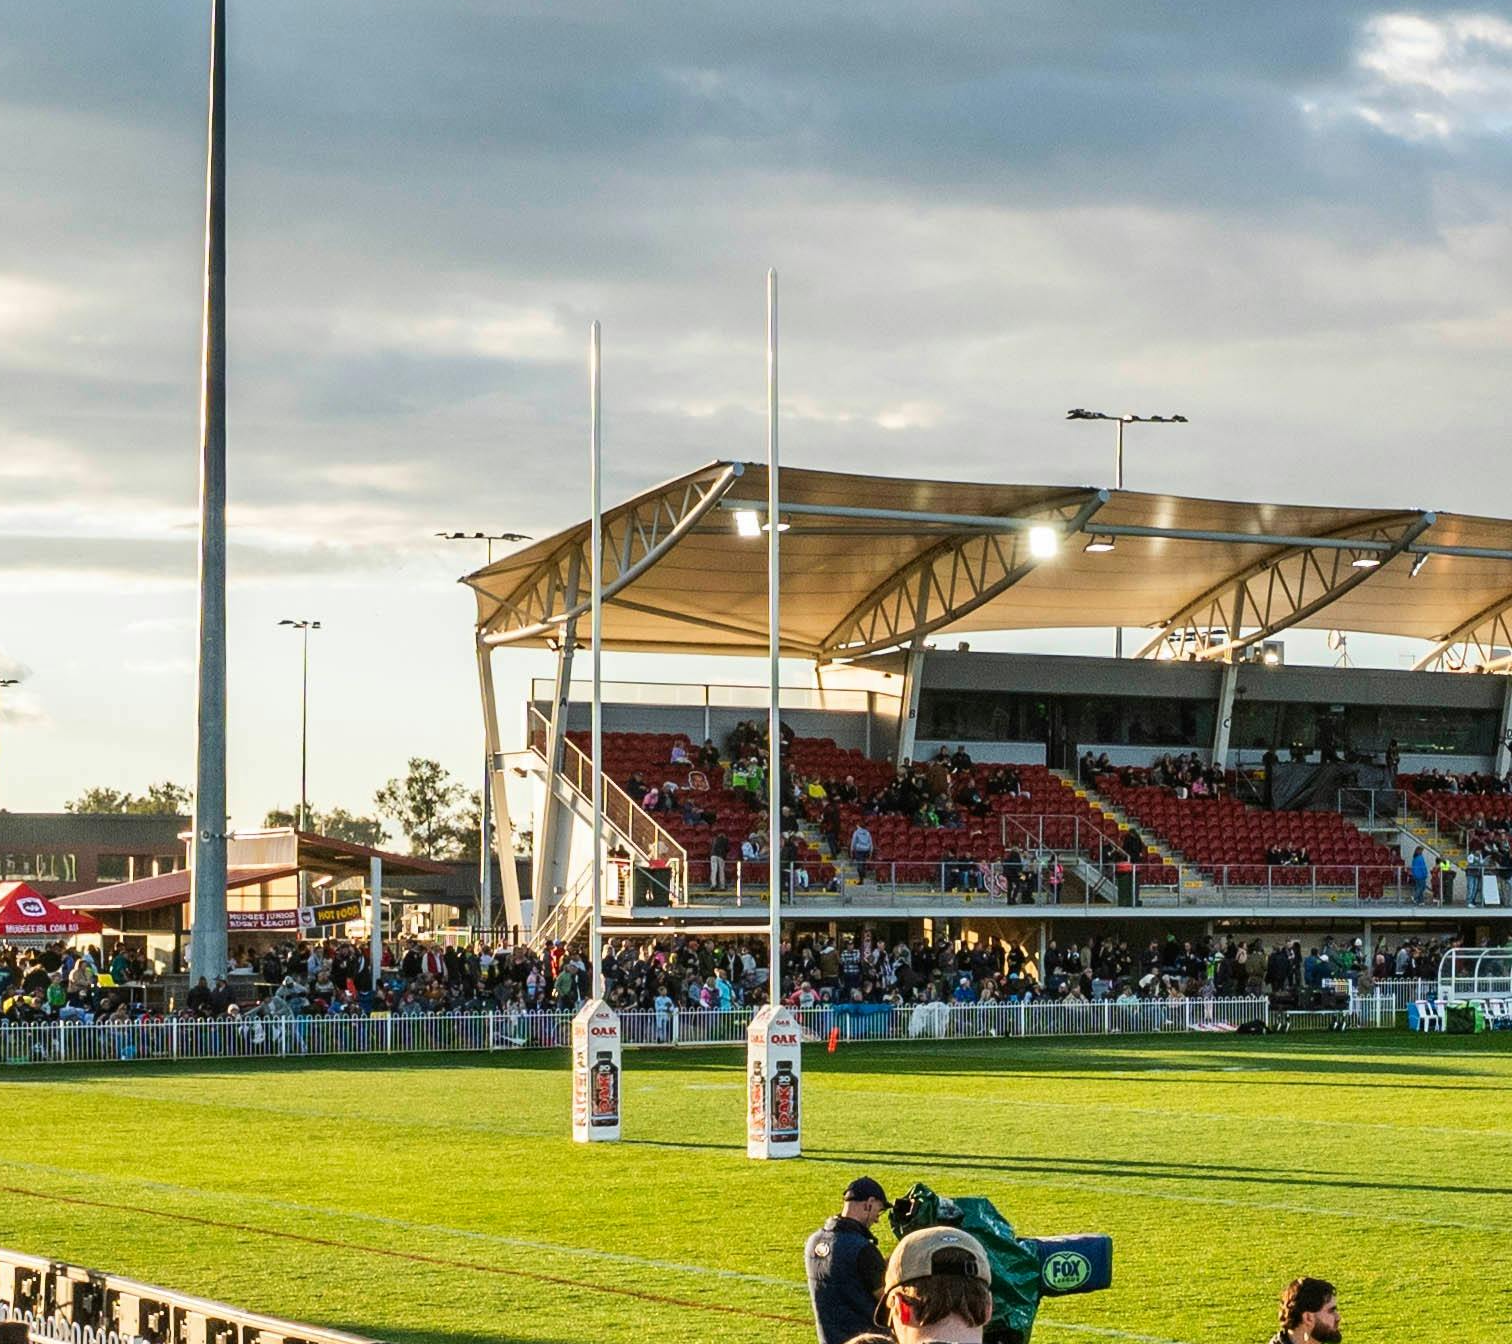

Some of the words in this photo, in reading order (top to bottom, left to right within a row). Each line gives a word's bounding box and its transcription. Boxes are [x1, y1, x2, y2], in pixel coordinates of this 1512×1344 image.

[229, 912, 265, 920] MUDGEE
[266, 911, 296, 919] JUNIOR
[318, 910, 335, 920] HOT
[261, 919, 296, 927] LEAGUE
[591, 1027, 617, 1035] OAK
[771, 1034, 797, 1043] OAK
[1053, 1260, 1081, 1277] FOX
